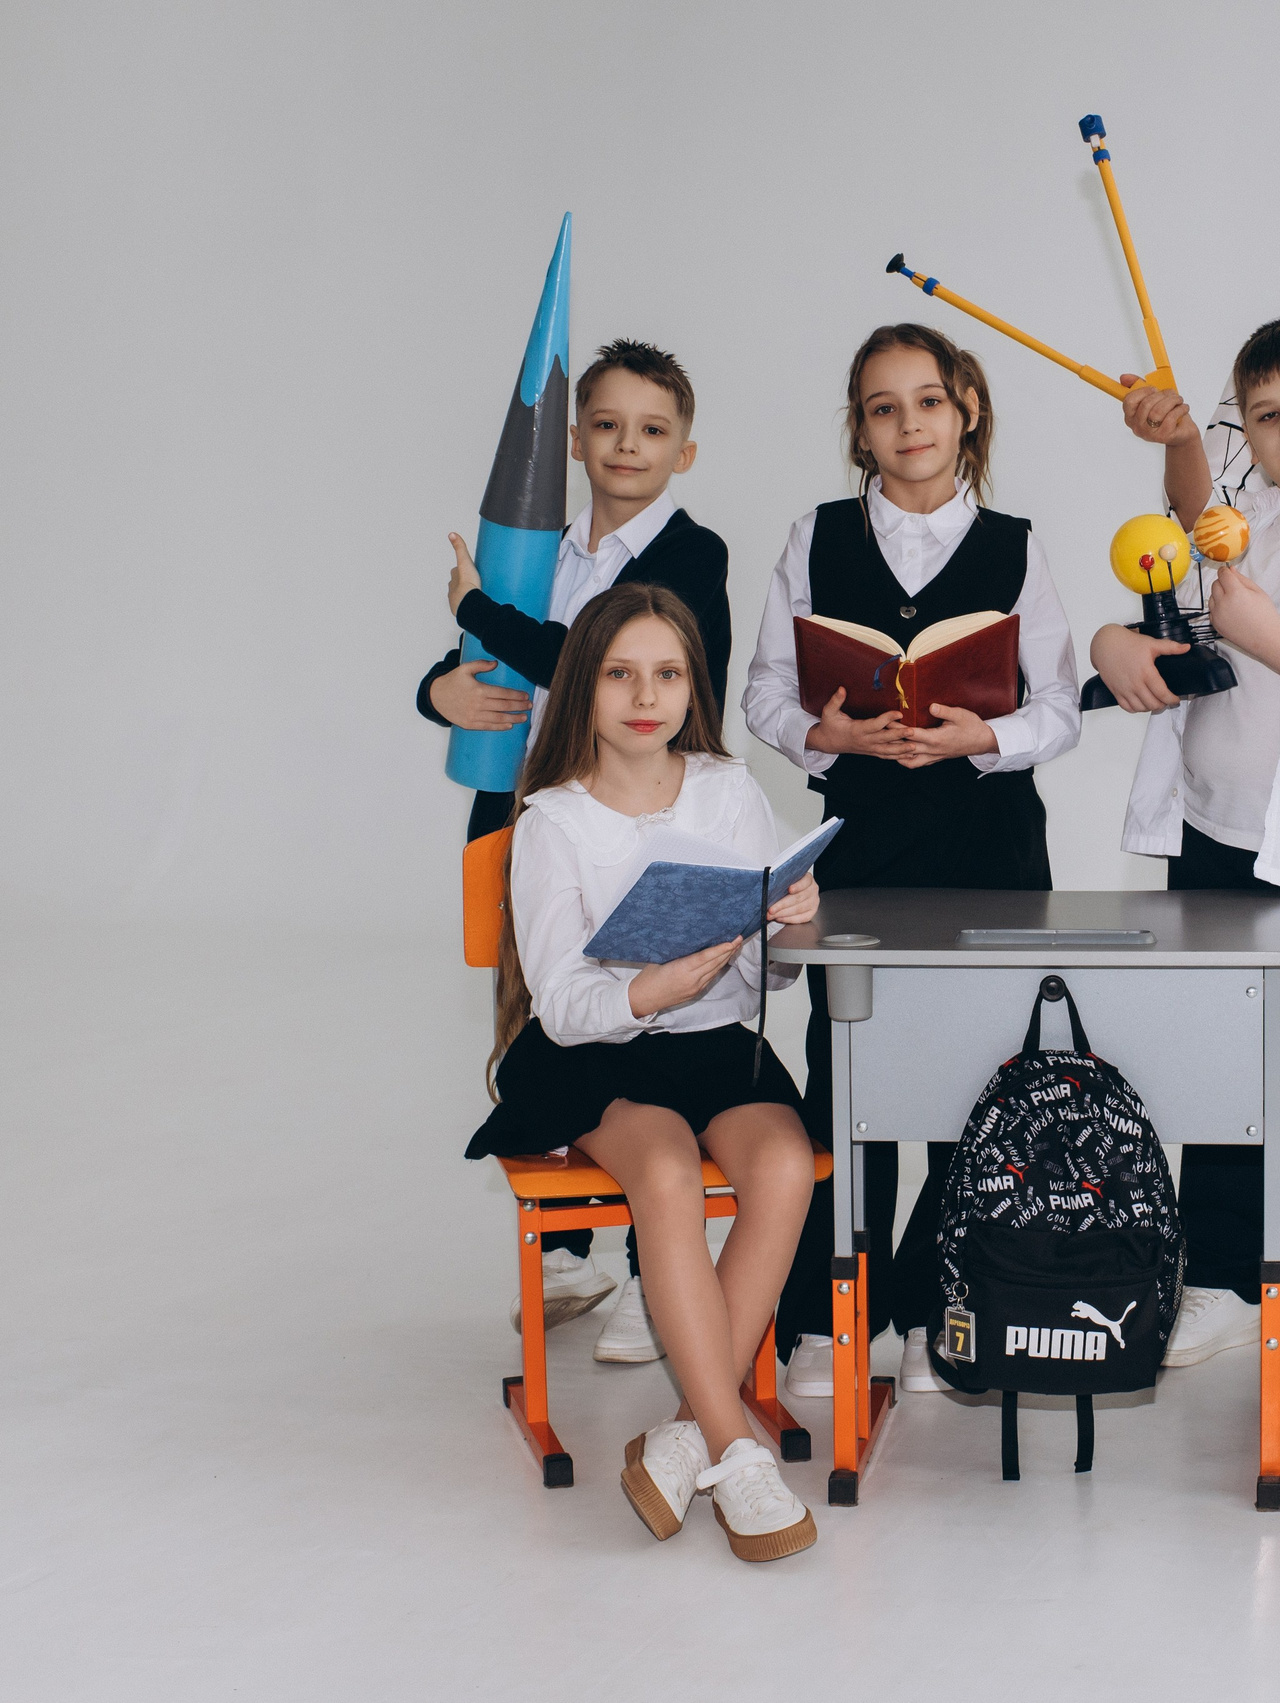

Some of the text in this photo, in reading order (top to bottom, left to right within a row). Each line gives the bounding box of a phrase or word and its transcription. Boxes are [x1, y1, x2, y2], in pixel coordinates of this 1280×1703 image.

[1045, 1055, 1096, 1070] PUMA
[1025, 1080, 1041, 1090] WE
[1104, 1106, 1143, 1139] PUMA
[1049, 1180, 1064, 1191] WE
[1049, 1193, 1094, 1210] PUMA
[1130, 1188, 1145, 1200] WE
[990, 1197, 1012, 1219] PUMA
[1046, 1213, 1070, 1226] COOL
[956, 1332, 964, 1352] 7
[1006, 1326, 1107, 1360] PUMA
